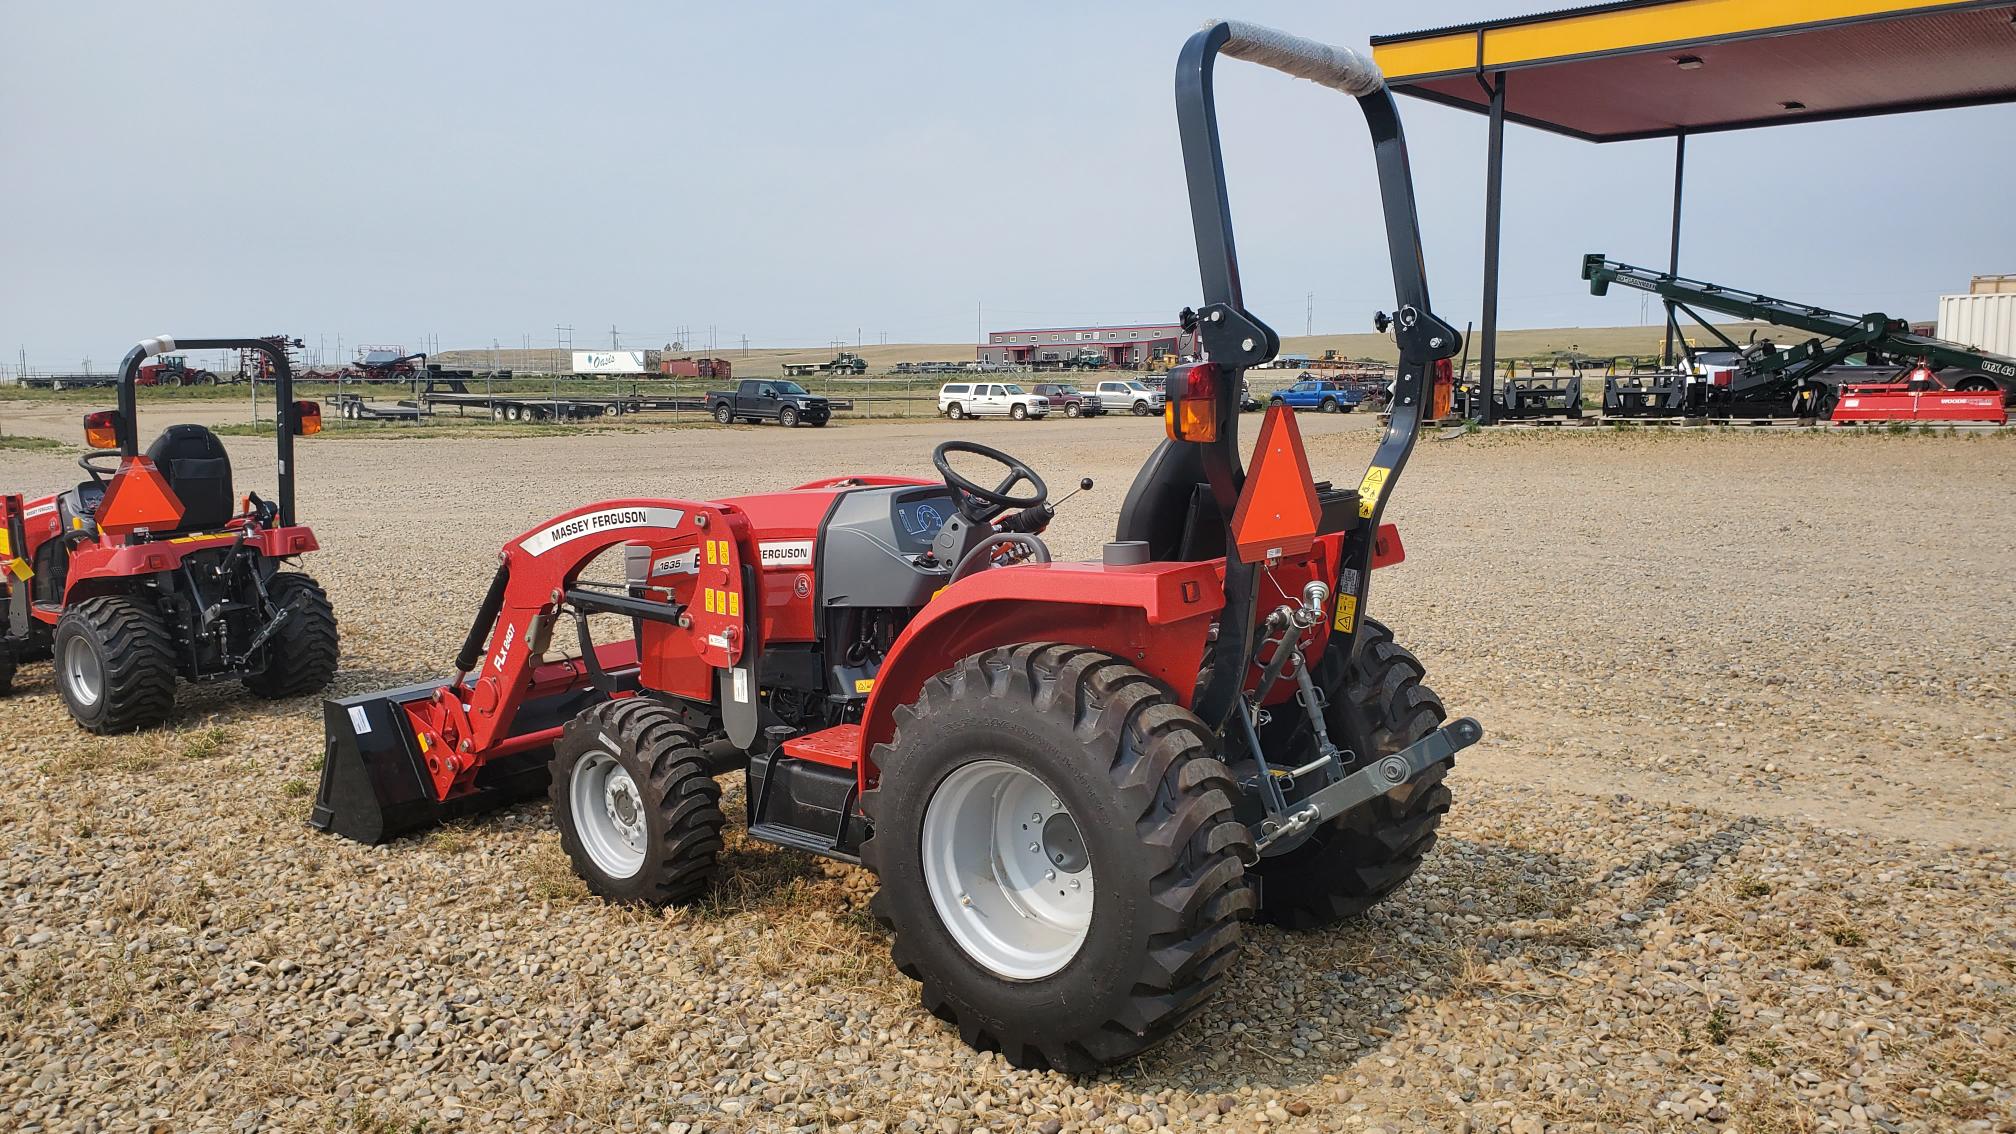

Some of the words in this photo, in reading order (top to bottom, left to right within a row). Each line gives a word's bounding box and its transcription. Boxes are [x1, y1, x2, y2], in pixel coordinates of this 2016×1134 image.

[1982, 361, 2001, 373] UTX
[2001, 366, 2015, 376] 44
[551, 519, 589, 542] MASSEY
[592, 511, 647, 528] FERGUSON
[494, 647, 507, 672] FLX
